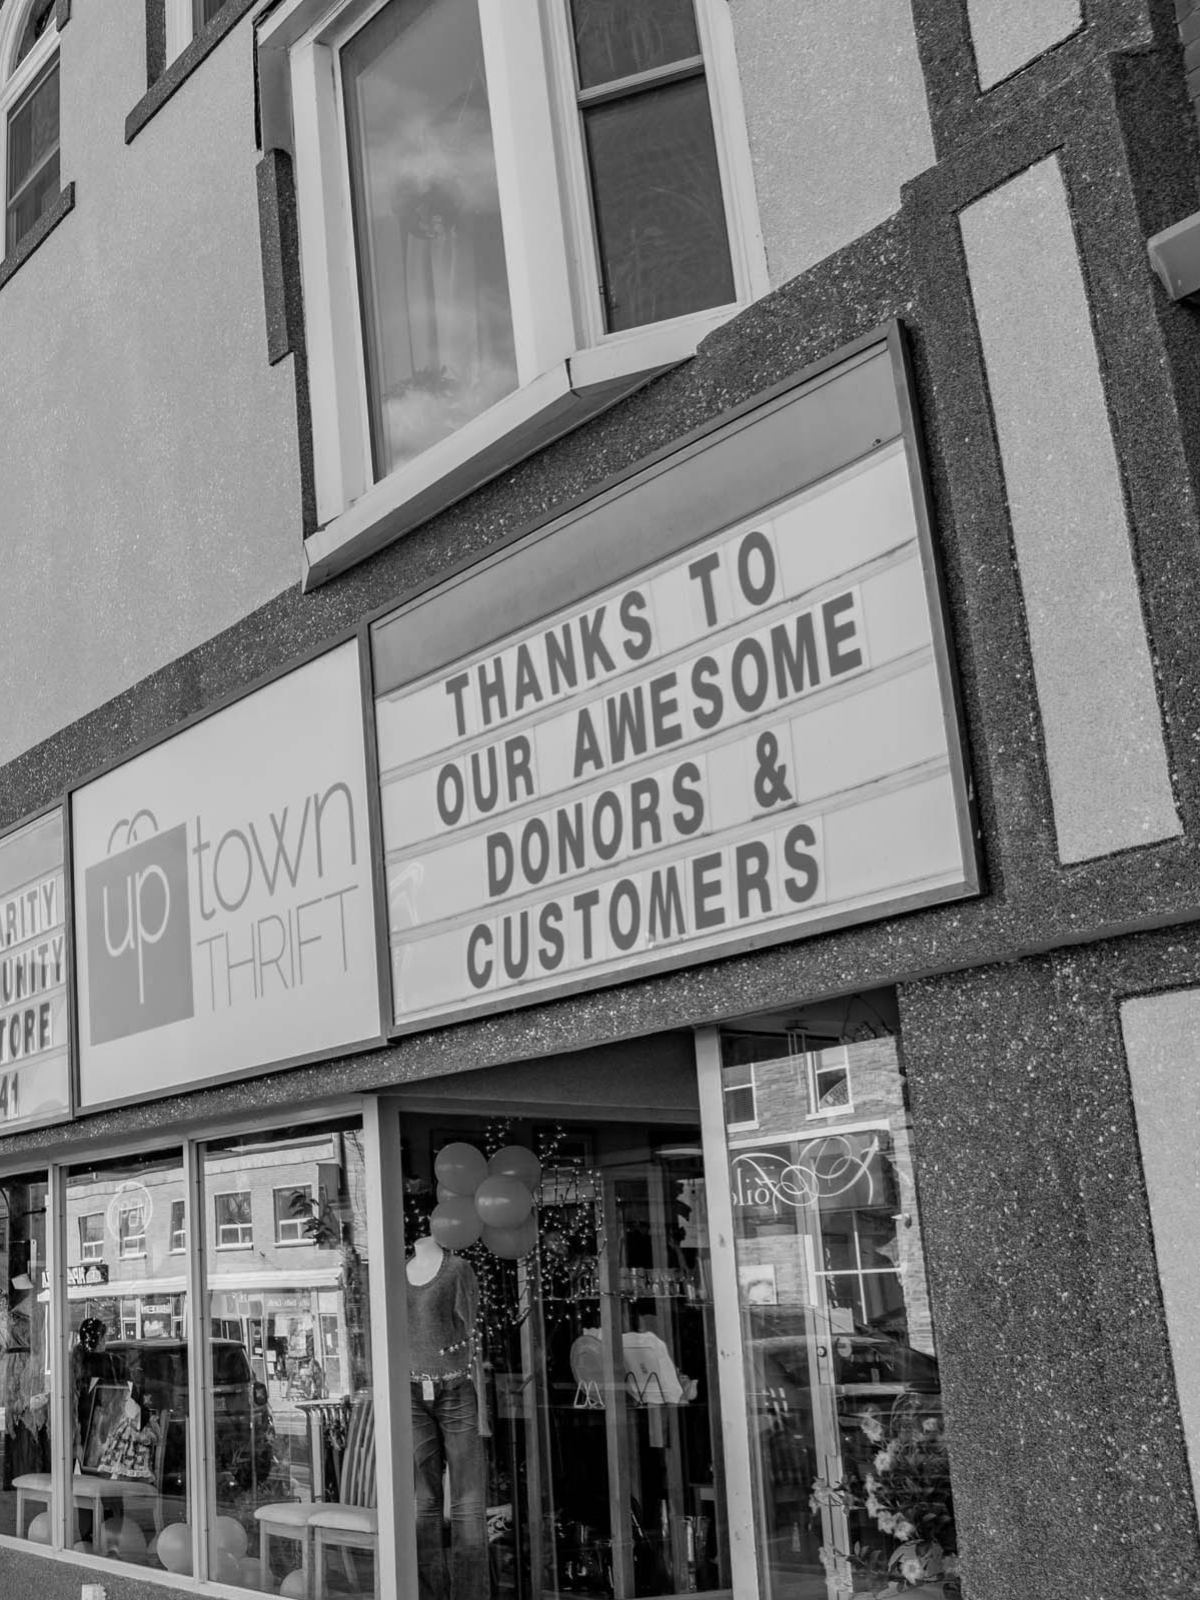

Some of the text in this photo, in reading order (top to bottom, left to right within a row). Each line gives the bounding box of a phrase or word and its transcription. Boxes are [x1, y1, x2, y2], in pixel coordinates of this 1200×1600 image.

[436, 591, 863, 827] OUR AWESOME
[445, 531, 776, 737] THANKS TO
[486, 730, 793, 898] DONORS &
[197, 884, 360, 1012] THRIFT
[466, 823, 820, 989] CUSTOMERS
